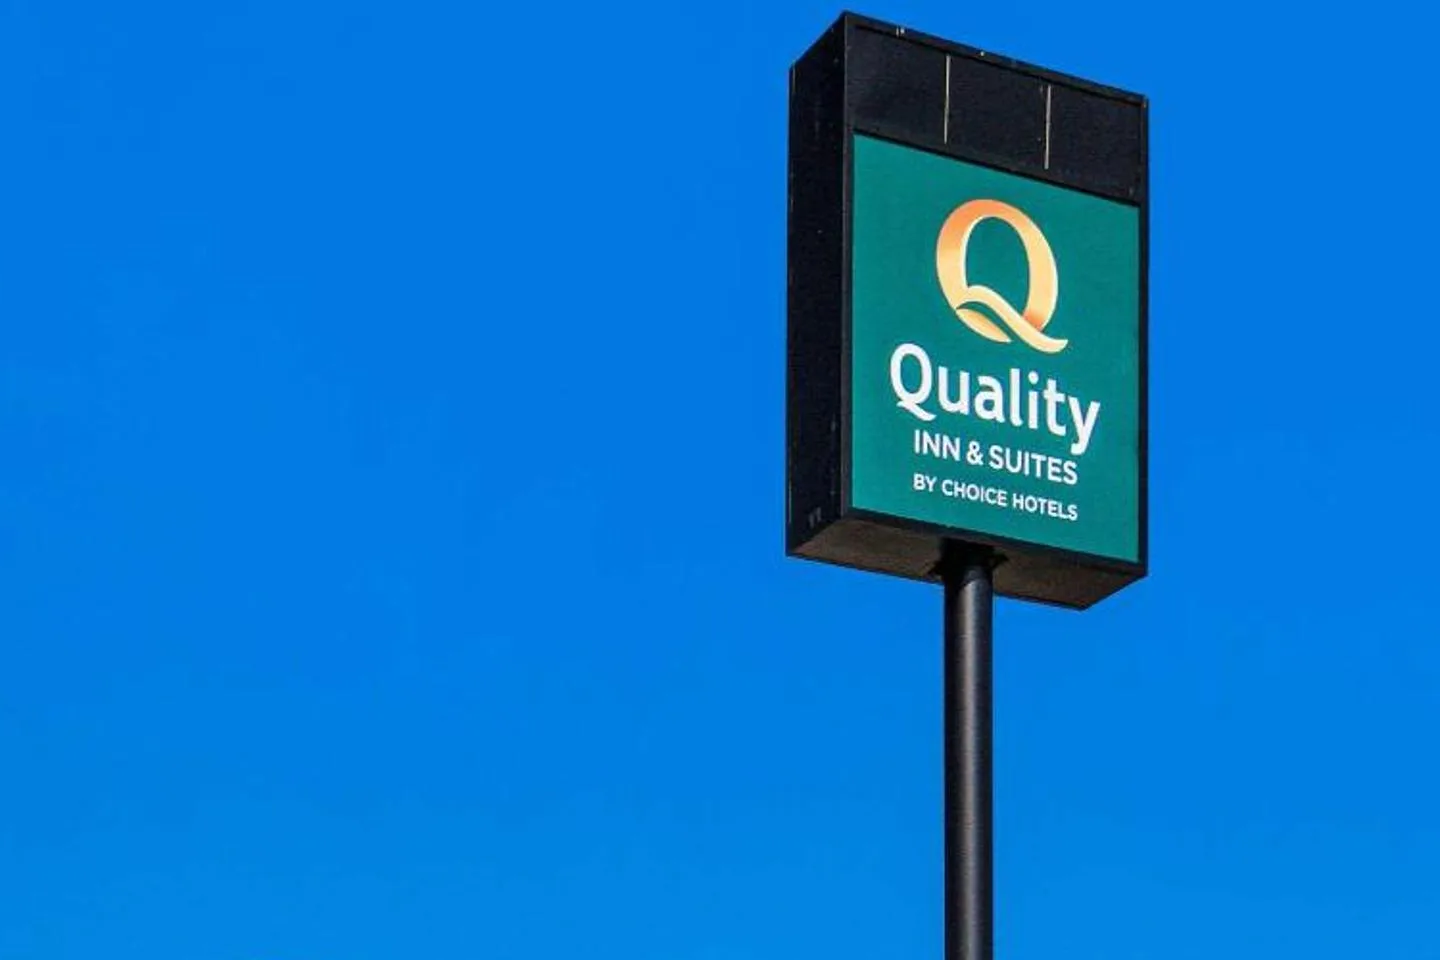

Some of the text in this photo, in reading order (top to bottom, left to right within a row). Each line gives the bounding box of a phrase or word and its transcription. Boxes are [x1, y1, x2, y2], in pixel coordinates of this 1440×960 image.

[935, 198, 1069, 354] Q
[890, 343, 1101, 456] Quality
[913, 473, 1078, 521] BY CHOICE HOTELS
[914, 429, 1078, 485] INN & SUITES
